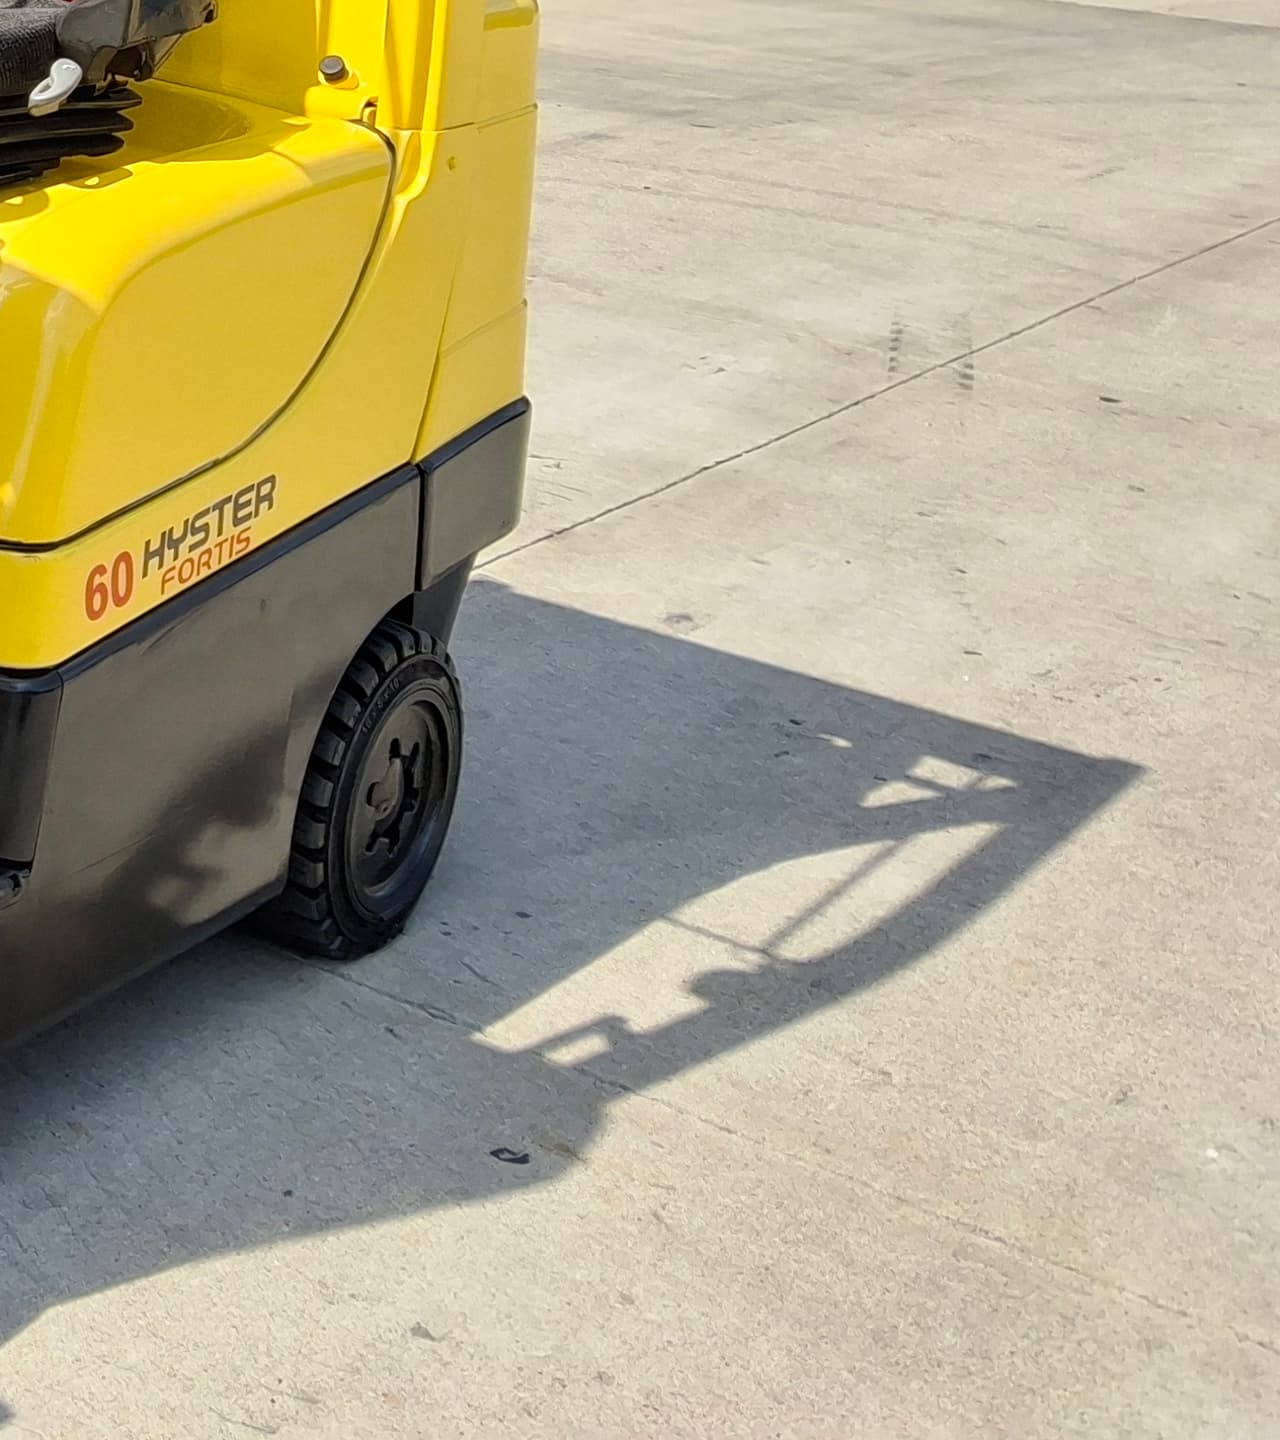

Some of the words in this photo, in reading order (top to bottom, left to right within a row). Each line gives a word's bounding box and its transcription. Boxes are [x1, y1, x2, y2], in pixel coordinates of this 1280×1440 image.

[142, 474, 277, 580] HYSTER
[160, 526, 252, 596] FORTIS
[85, 550, 134, 621] 60
